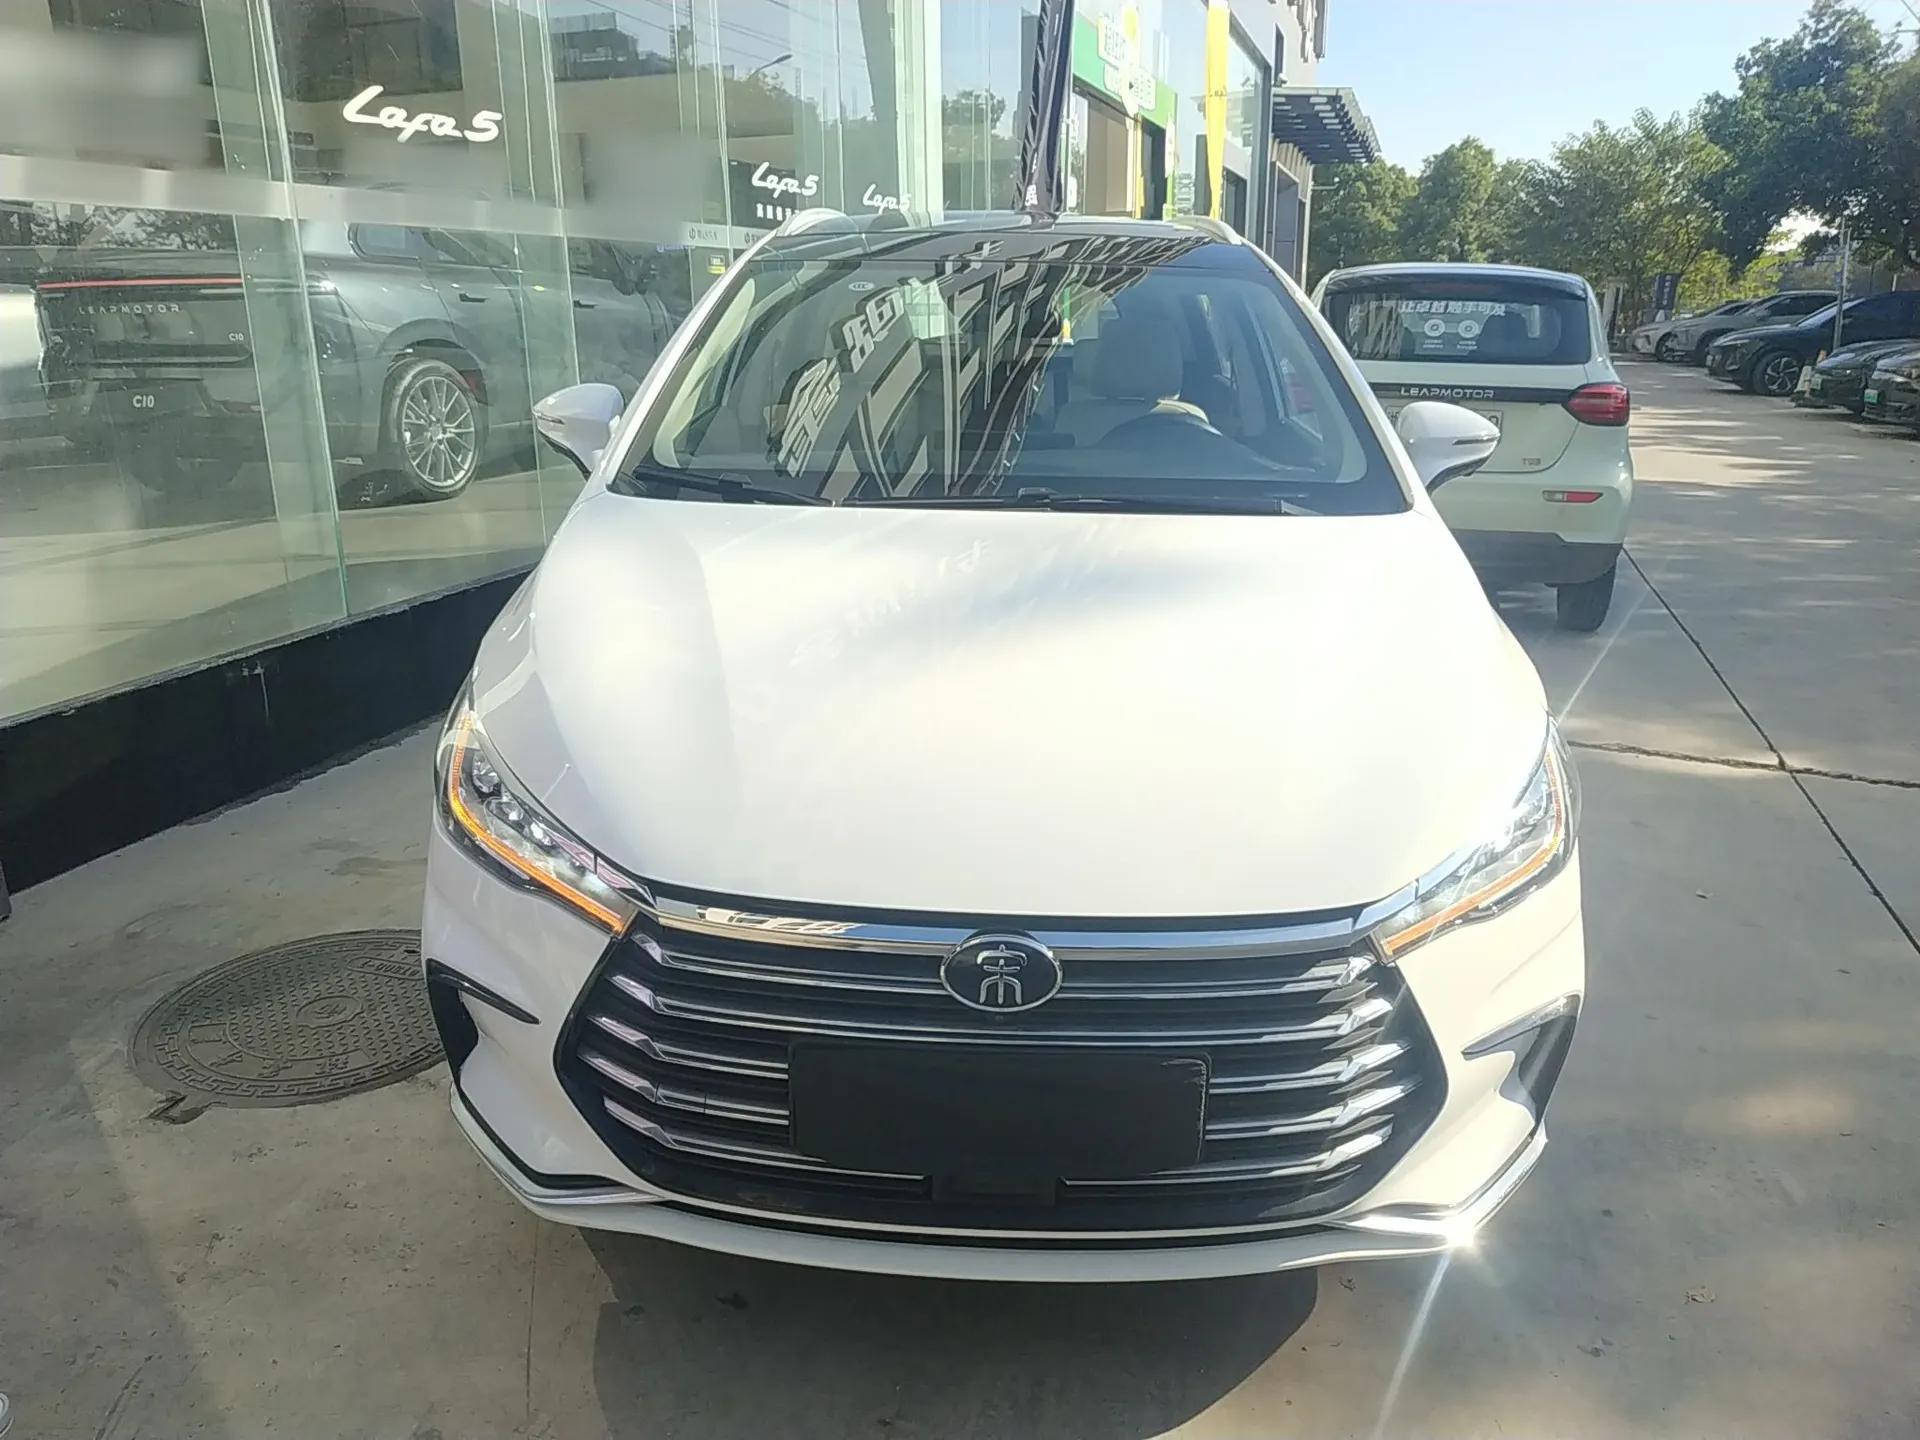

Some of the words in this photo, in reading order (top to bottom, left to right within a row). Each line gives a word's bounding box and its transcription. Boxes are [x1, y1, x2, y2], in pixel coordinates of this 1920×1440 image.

[79, 304, 182, 315] LEAPMOTOR
[1400, 386, 1495, 399] LEAPMOTOR
[132, 395, 155, 408] C10
